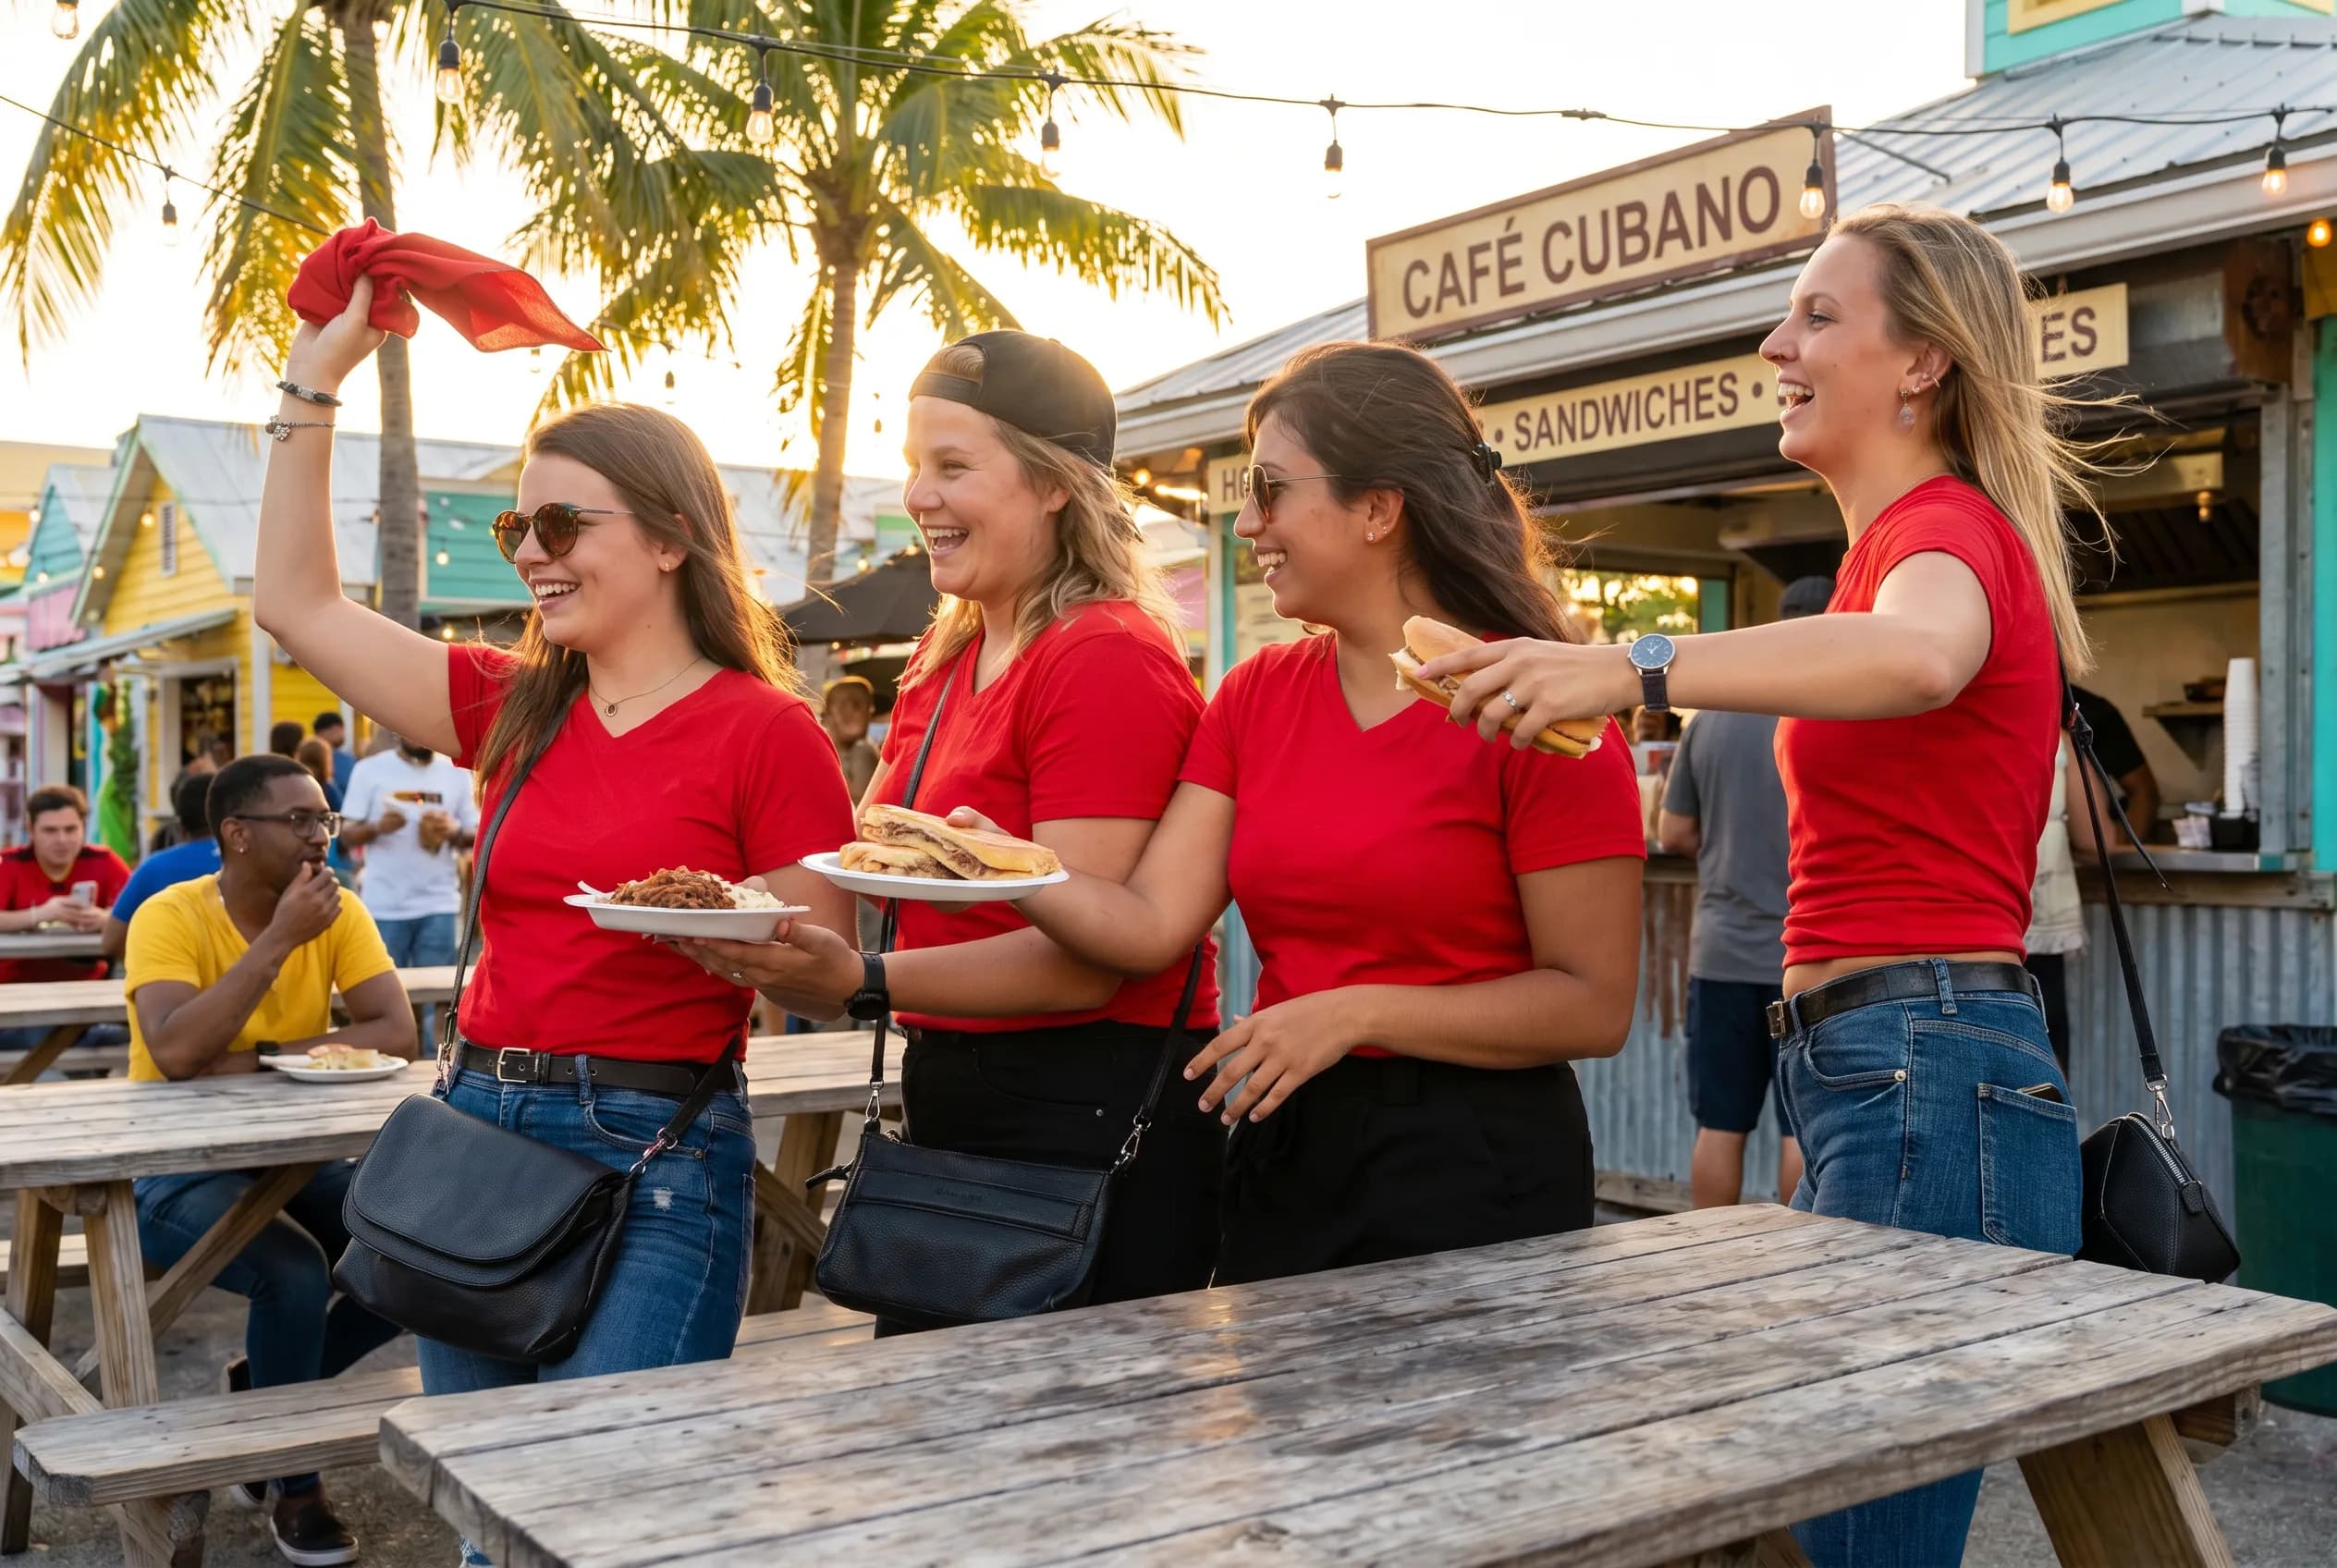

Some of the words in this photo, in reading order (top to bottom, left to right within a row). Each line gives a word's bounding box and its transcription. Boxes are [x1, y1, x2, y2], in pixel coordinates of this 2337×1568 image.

[1403, 216, 1525, 319] CAFÉ
[1542, 165, 1780, 285] CUBANO
[1514, 372, 1739, 452] SANDWICHES
[2040, 306, 2098, 363] ES
